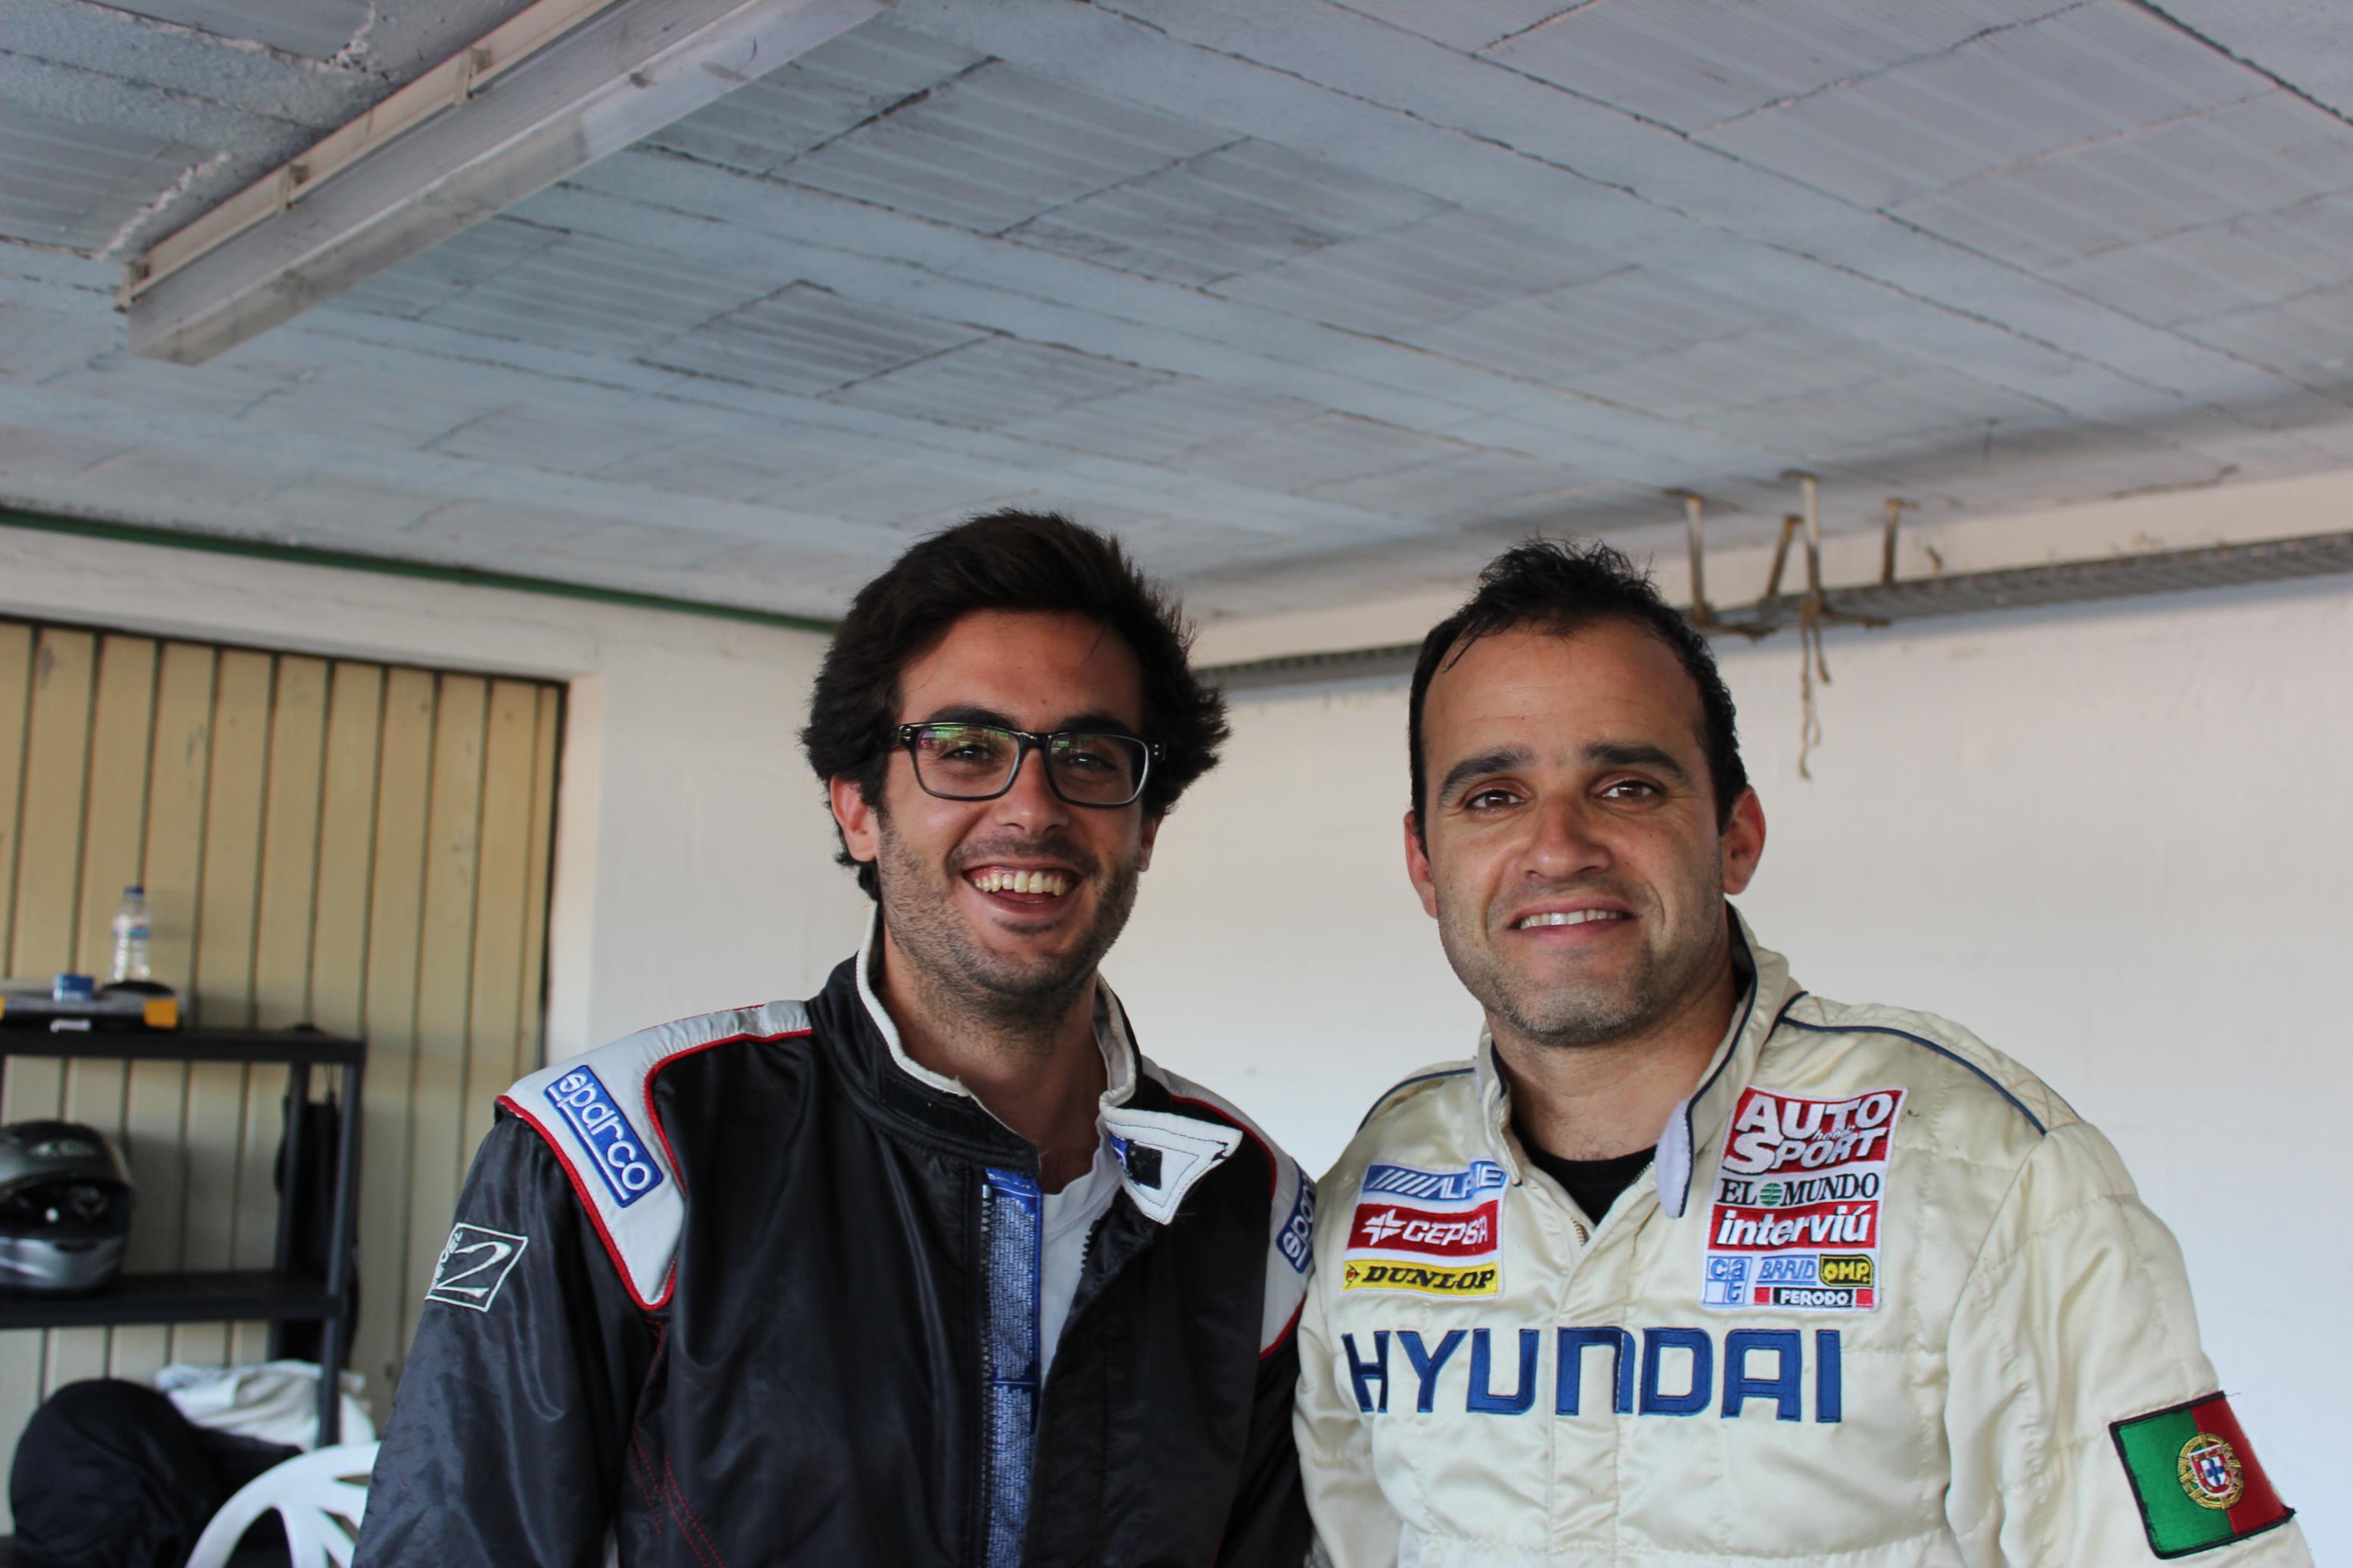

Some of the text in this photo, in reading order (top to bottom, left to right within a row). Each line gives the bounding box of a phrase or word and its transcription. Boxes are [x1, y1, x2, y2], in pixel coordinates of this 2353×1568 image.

[558, 1072, 651, 1191] sparco
[1735, 1094, 1894, 1140] AUTO
[1722, 1129, 1888, 1174] SPORT
[1717, 1172, 1879, 1206] EL MUNDO
[1403, 1215, 1489, 1246] CEPSA
[1716, 1204, 1871, 1246] interviú
[1362, 1265, 1495, 1290] DUNLOP
[1780, 1288, 1849, 1306] FERODO
[1341, 1327, 1842, 1424] HYUNDAI
